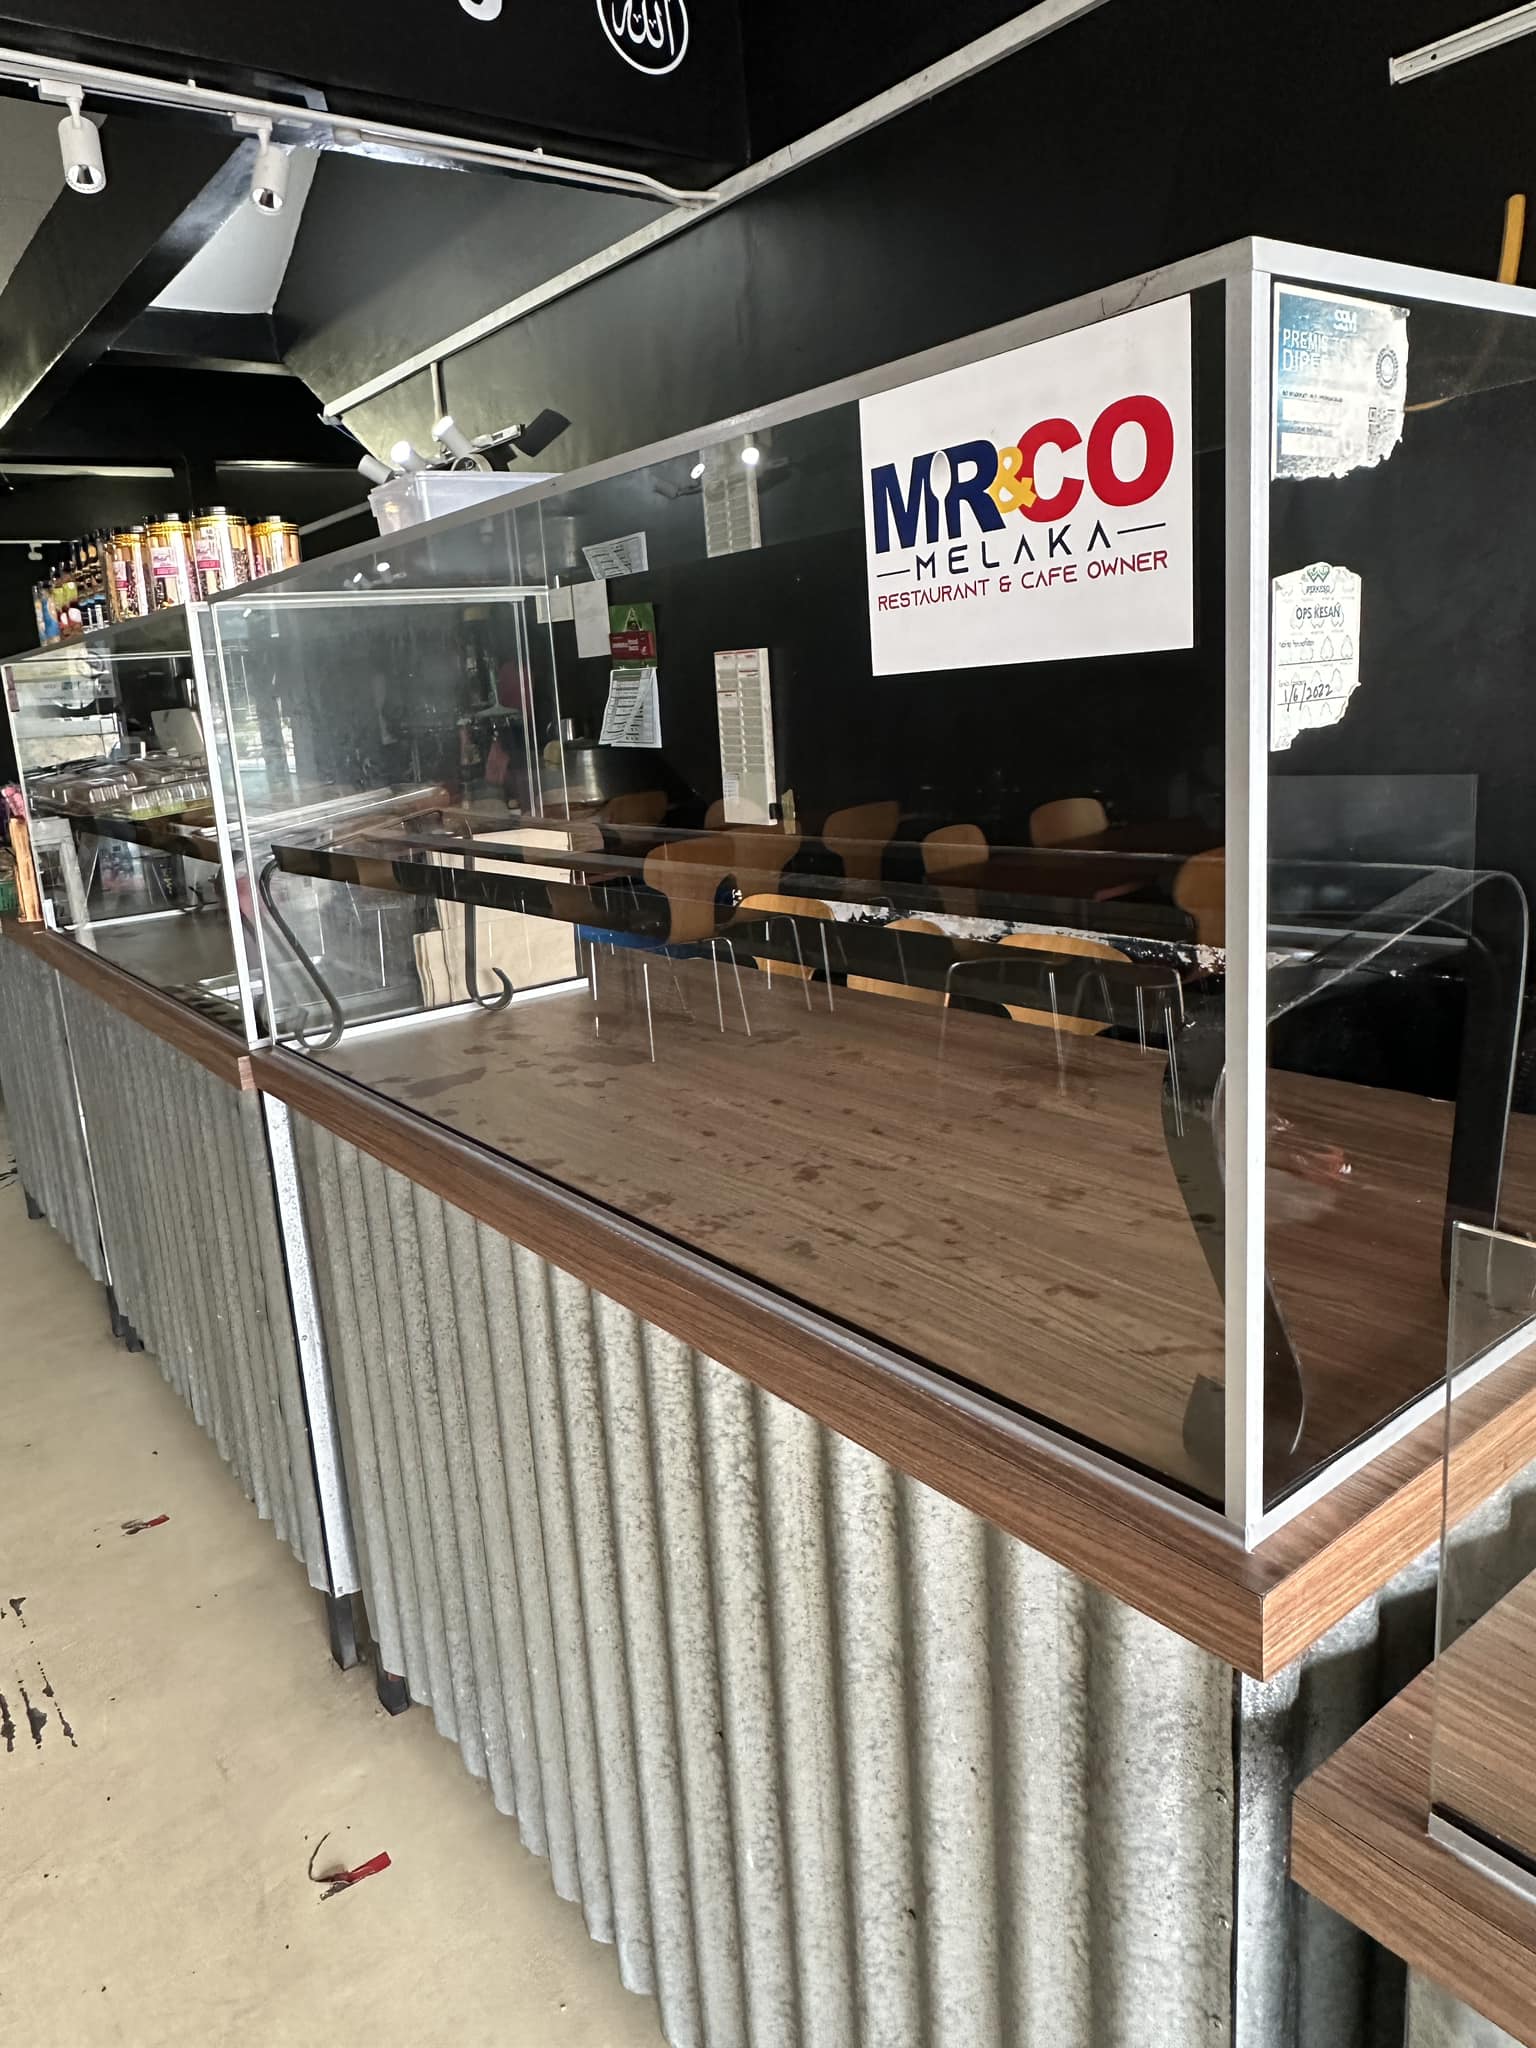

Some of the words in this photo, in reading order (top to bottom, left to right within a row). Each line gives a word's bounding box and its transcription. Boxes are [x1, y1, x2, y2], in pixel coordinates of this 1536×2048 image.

[877, 578, 990, 612] RESTAURANT
[999, 575, 1012, 593] &
[1021, 564, 1078, 590] CAFE
[1087, 549, 1168, 580] OWNER
[915, 519, 1113, 581] MELAKA
[1295, 606, 1313, 620] OPS
[1313, 605, 1341, 619] KESAN
